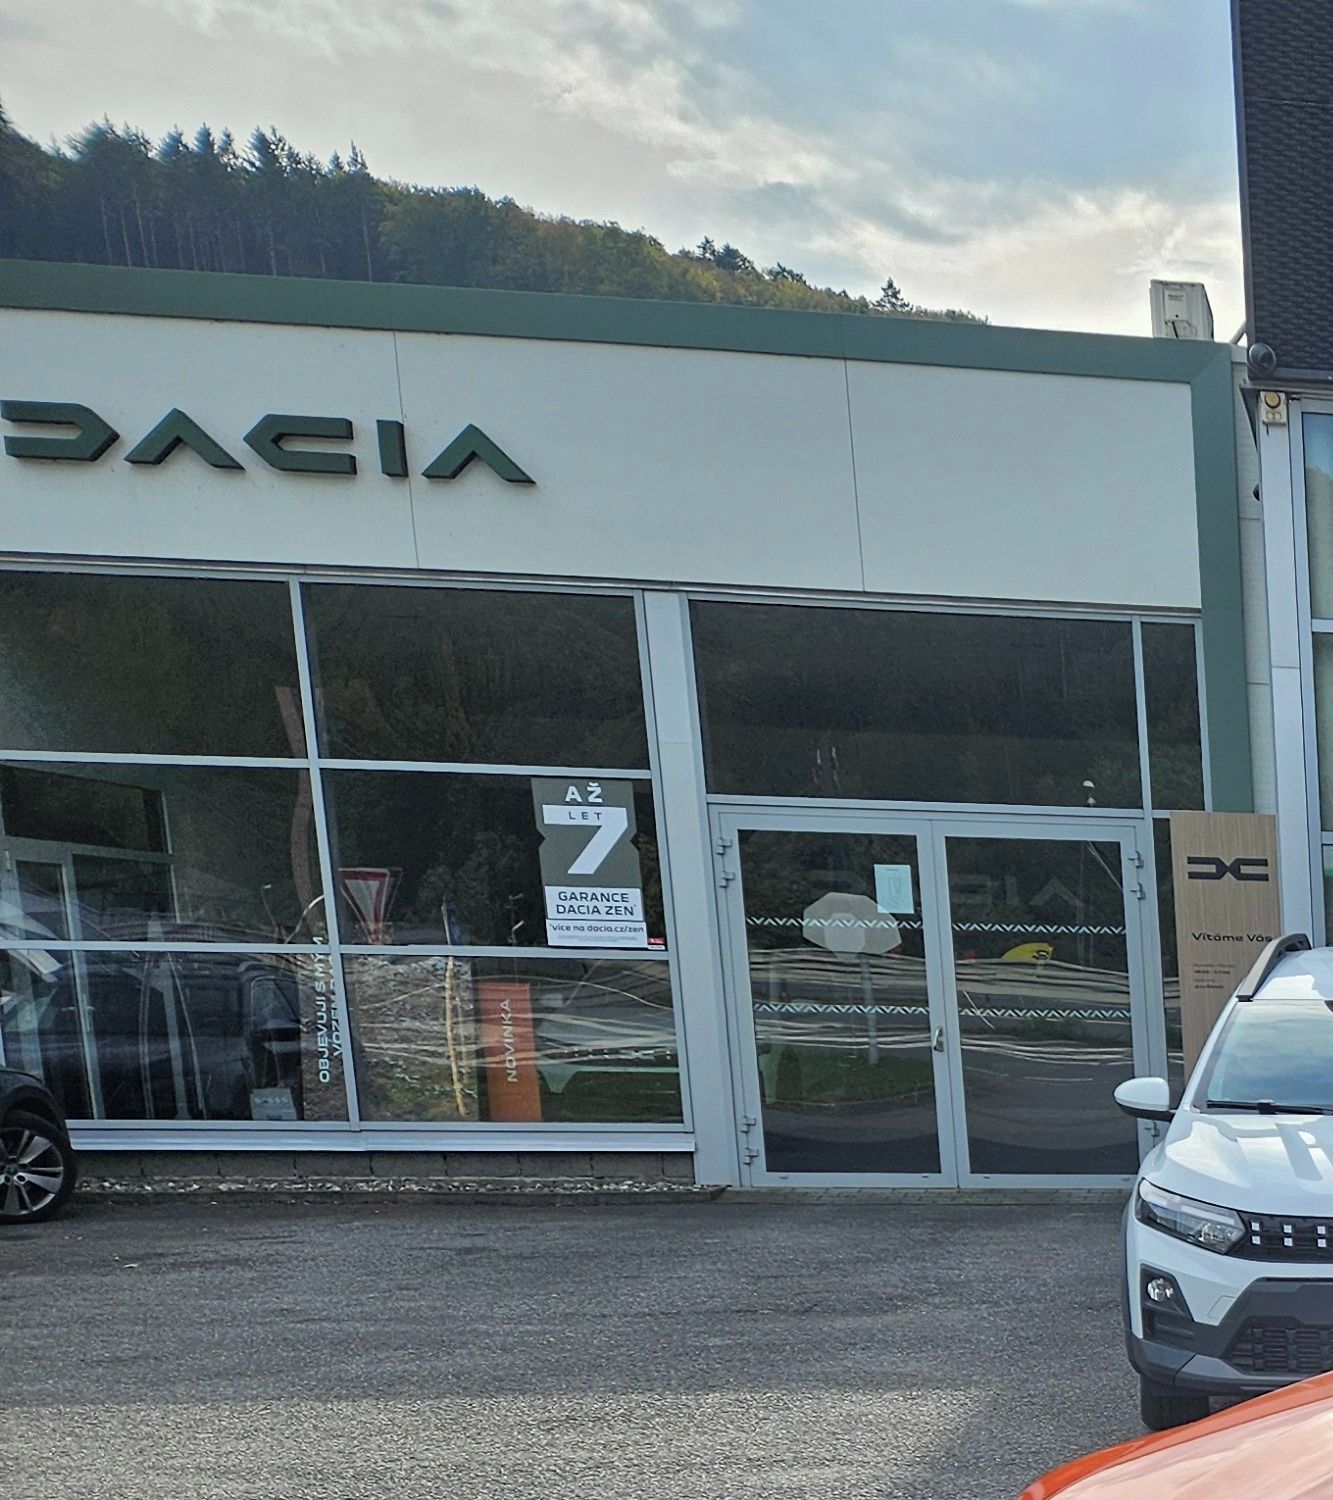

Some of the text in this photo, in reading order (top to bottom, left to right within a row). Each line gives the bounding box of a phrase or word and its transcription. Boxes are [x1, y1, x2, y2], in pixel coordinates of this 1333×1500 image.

[0, 399, 536, 485] DACIA
[565, 782, 603, 803] AŽ
[568, 811, 602, 821] LET
[542, 804, 629, 875] 7
[558, 891, 629, 903] GARANCE
[556, 904, 601, 915] DACIA
[587, 924, 644, 933] dacia.cz/zen
[315, 981, 326, 993] S
[315, 997, 330, 1083] OBJEVUJI
[500, 999, 519, 1083] NOVINKA
